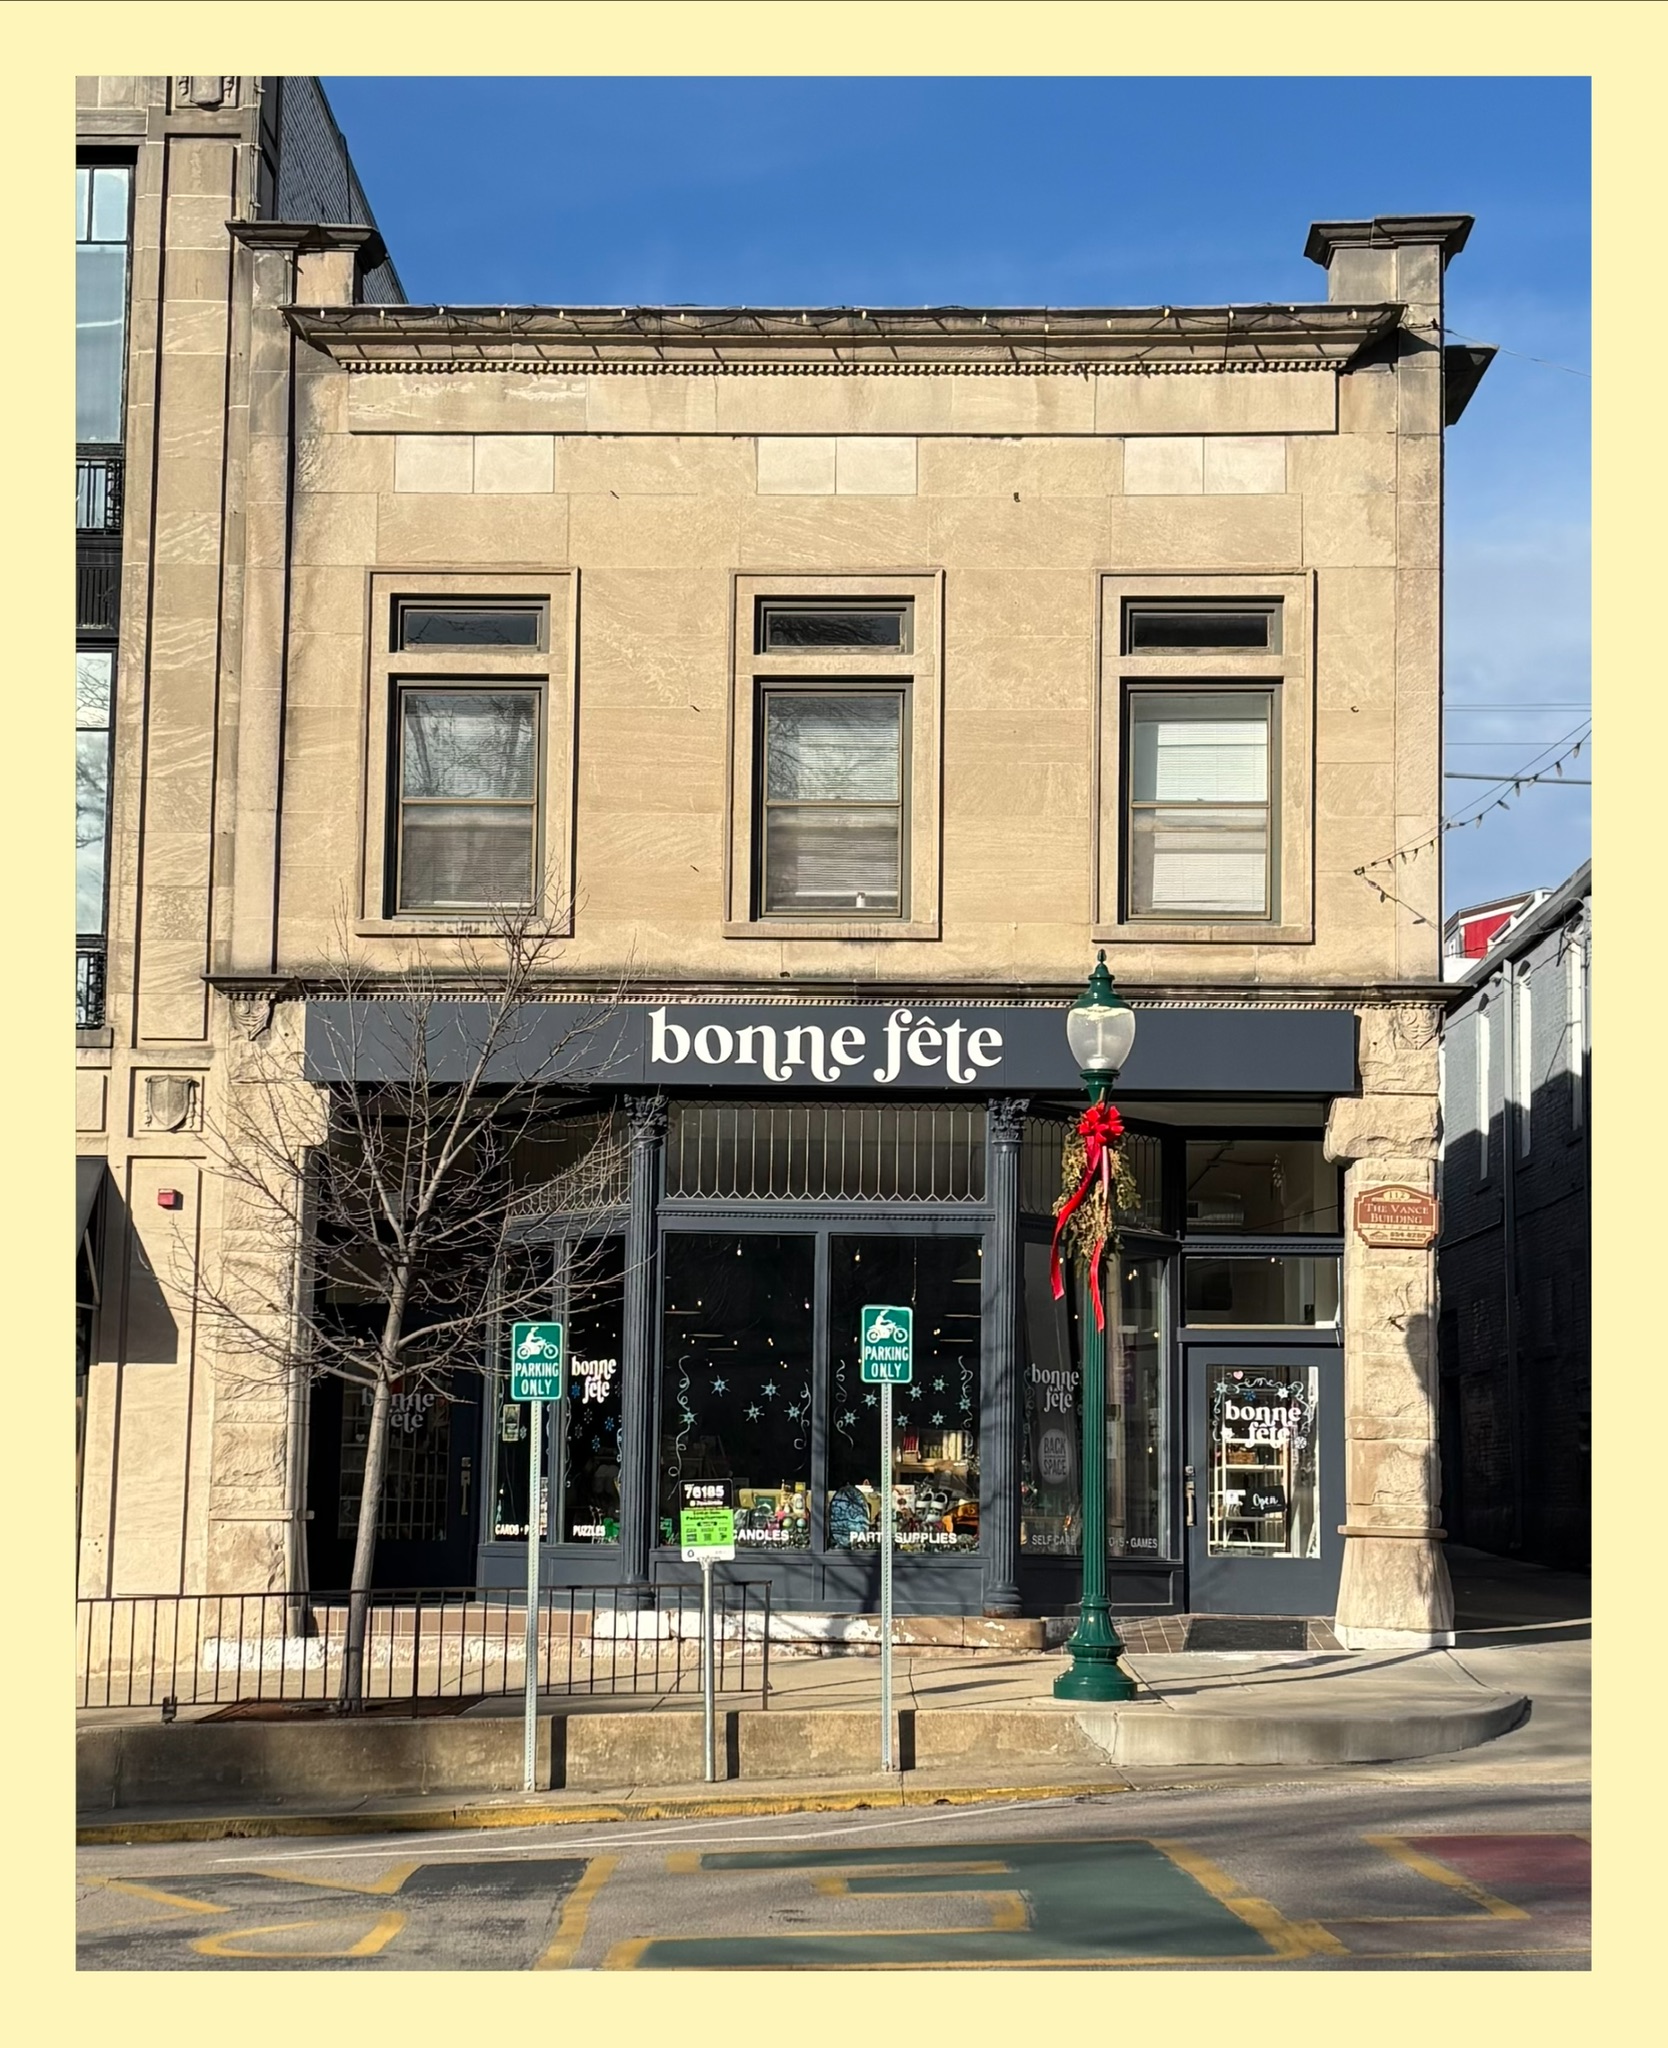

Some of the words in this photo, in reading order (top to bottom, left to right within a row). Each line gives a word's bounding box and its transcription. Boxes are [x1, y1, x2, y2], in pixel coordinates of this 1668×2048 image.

[648, 1006, 866, 1082] bonne
[873, 1008, 1003, 1084] fête
[1389, 1191, 1406, 1199] 112
[1370, 1213, 1422, 1224] BUILDING
[865, 1346, 909, 1361] PARKING
[515, 1362, 559, 1377] PARKING
[571, 1355, 617, 1380] bonne
[871, 1363, 902, 1378] ONLY
[1032, 1363, 1079, 1392] bonne
[521, 1379, 552, 1396] ONLY
[362, 1387, 435, 1412] bnne
[1044, 1385, 1073, 1413] fête
[388, 1408, 424, 1434] ête
[1225, 1400, 1302, 1427] bonne
[1245, 1421, 1291, 1448] fête
[1043, 1437, 1066, 1454] BACK
[1043, 1459, 1067, 1475] SPACE
[1252, 1493, 1279, 1510] Open
[495, 1524, 519, 1535] CARDS
[573, 1525, 606, 1537] PUZZLES
[850, 1531, 884, 1543] PART
[894, 1532, 957, 1544] SUPPLIES
[1130, 1537, 1158, 1549] GAMES
